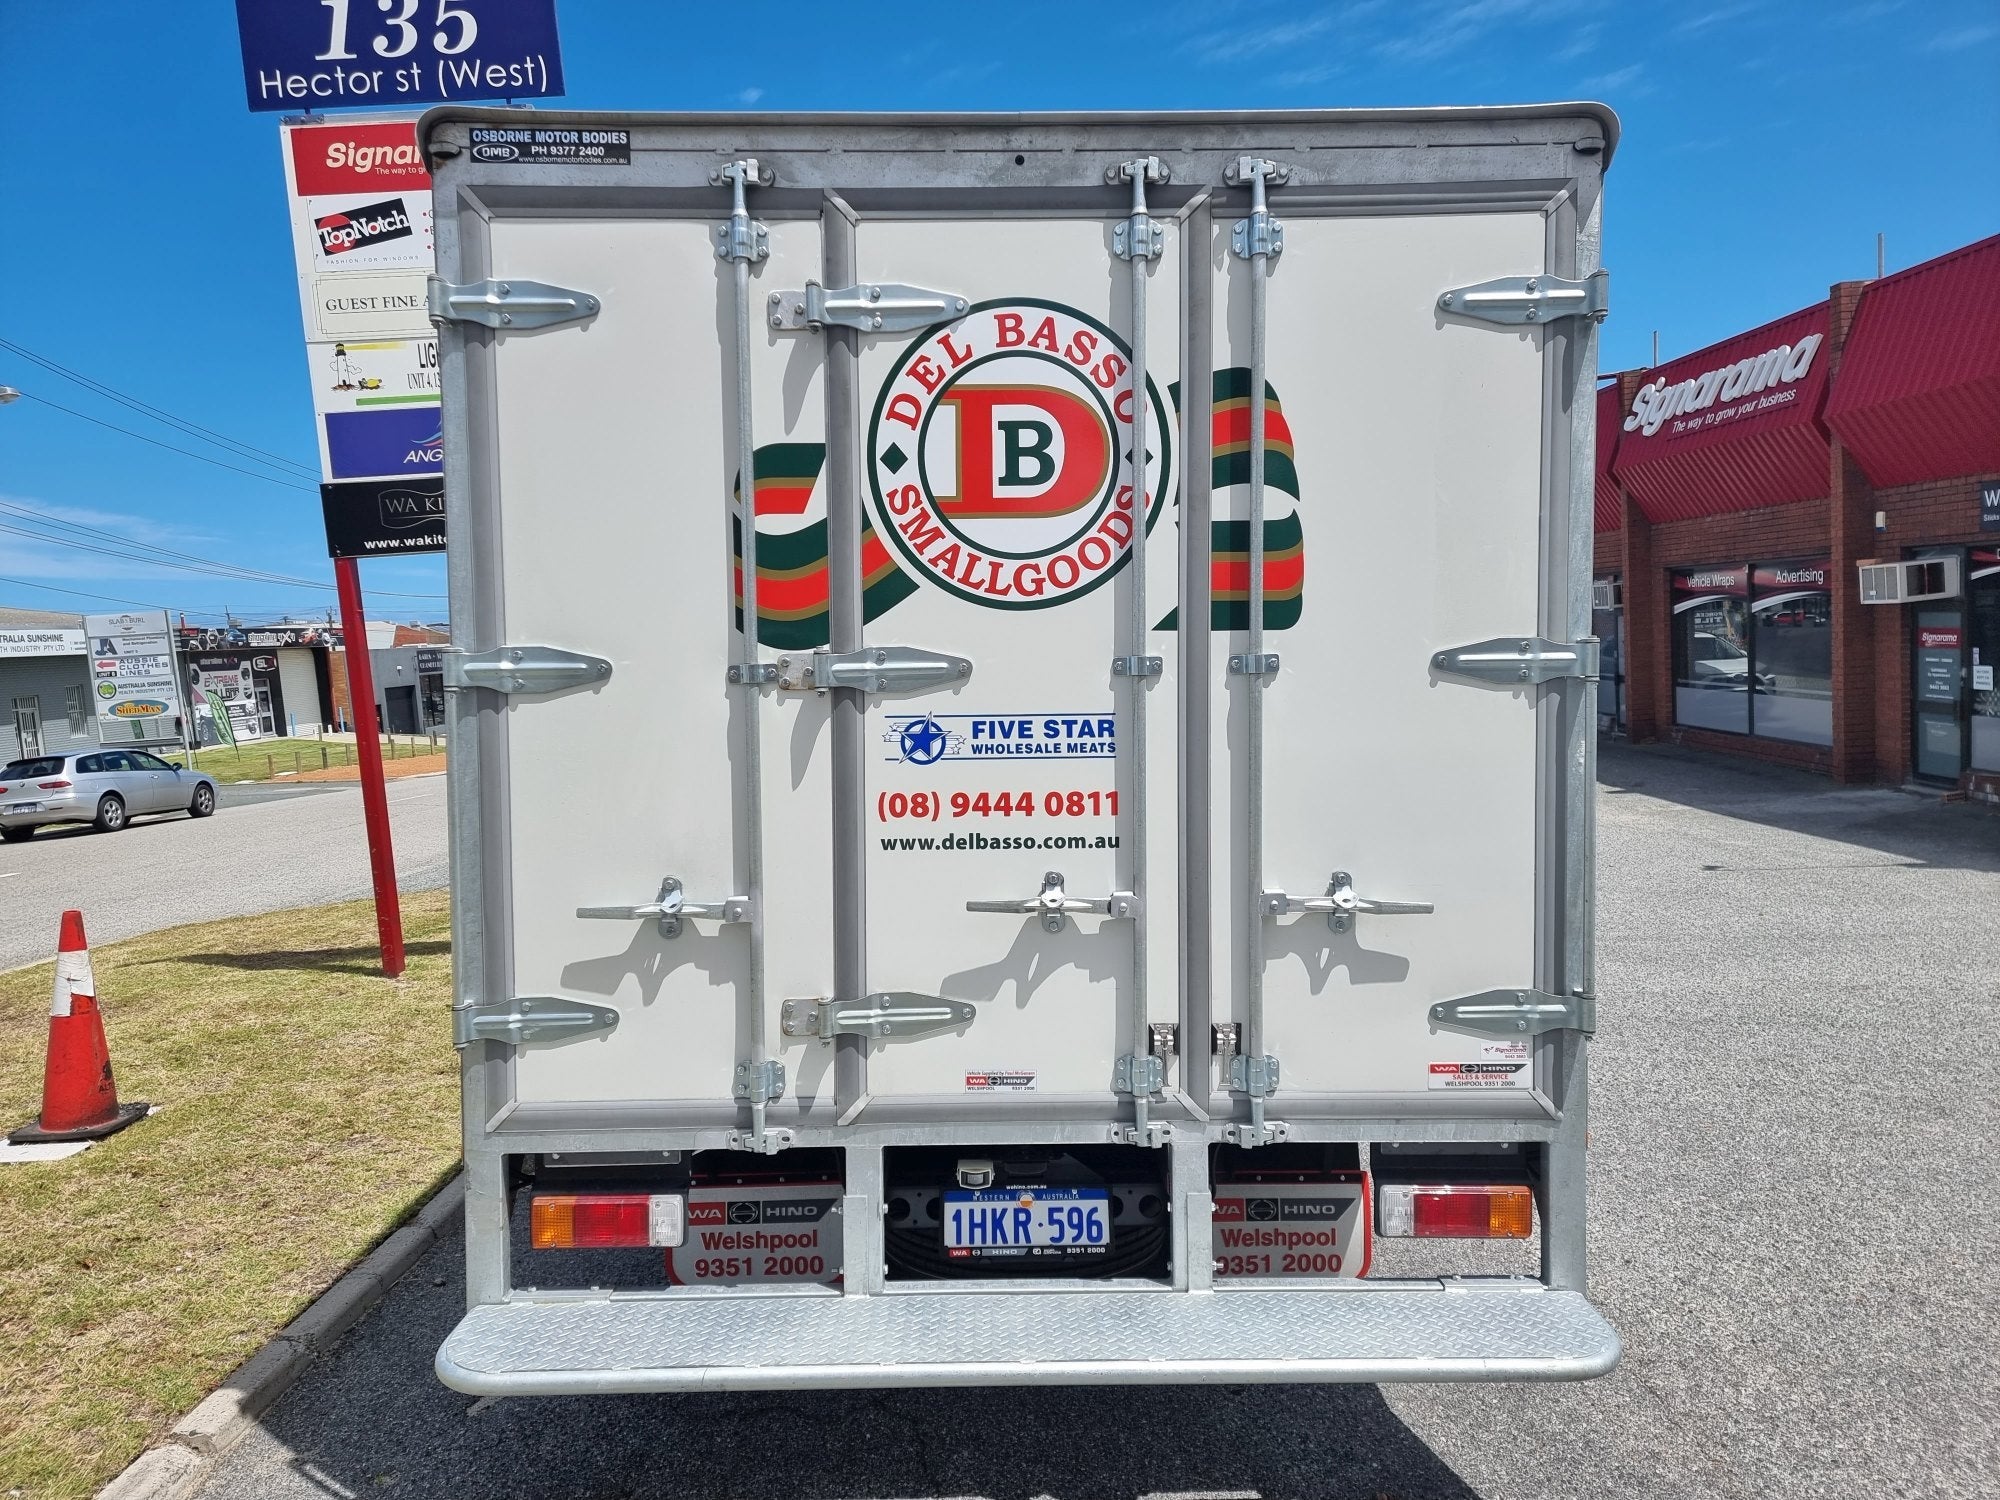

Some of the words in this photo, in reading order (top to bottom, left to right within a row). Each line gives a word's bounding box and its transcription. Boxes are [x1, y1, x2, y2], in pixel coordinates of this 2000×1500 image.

[315, 0, 478, 61] 135
[260, 66, 384, 99] Hector
[396, 62, 422, 93] st
[439, 54, 548, 98] (West)
[472, 130, 532, 143] OSBORNE
[535, 131, 580, 144] MOTOR
[582, 131, 628, 144] BODIES
[531, 145, 547, 155] PH
[550, 145, 576, 156] 9377
[578, 146, 605, 156] 2400
[375, 167, 390, 175] The
[391, 168, 407, 176] way
[317, 209, 410, 248] TopNotch
[326, 257, 359, 265] FASHION
[325, 297, 378, 312] GUEST
[382, 295, 419, 309] FINE
[407, 372, 426, 390] UNIT
[885, 332, 973, 432] DEL
[1623, 333, 1824, 437] Signarama
[1672, 420, 1685, 434] The
[1687, 416, 1703, 430] way
[1705, 413, 1715, 425] to
[1714, 407, 1736, 425] grow
[1738, 401, 1757, 419] your
[1757, 388, 1797, 410] business
[386, 497, 419, 513] WA
[425, 497, 445, 511] KI
[885, 484, 1151, 597] SMALLGOODS
[1686, 575, 1711, 588] Vehicle
[1711, 573, 1735, 589] Wraps
[1775, 568, 1824, 585] Advertising
[27, 633, 64, 643] SUNSHINE
[1922, 632, 1958, 643] Signarama
[10, 645, 41, 653] INDUSTRY
[55, 644, 66, 652] LTD
[119, 661, 168, 671] CLOTHES
[119, 669, 151, 677] LINES
[117, 682, 146, 690] AUSTRALIA
[204, 673, 239, 688] EXTREME
[971, 719, 1033, 739] FIVE
[1043, 719, 1115, 738] STAR
[971, 743, 1061, 755] WHOLESALE
[1066, 741, 1116, 754] MEATS
[878, 791, 940, 822] (08)
[950, 791, 1035, 818] 9444
[1043, 790, 1119, 817] 0811
[880, 833, 1120, 851] www.delbasso.com.au
[688, 1208, 722, 1219] WA
[766, 1206, 818, 1217] HINO
[1284, 1205, 1336, 1215] HINO
[700, 1229, 818, 1253] Welshpool
[1220, 1228, 1337, 1250] Welshpool
[694, 1257, 752, 1278] 9351
[763, 1255, 824, 1276] 2000
[1216, 1254, 1271, 1275] 9351
[1282, 1253, 1342, 1273] 2000
